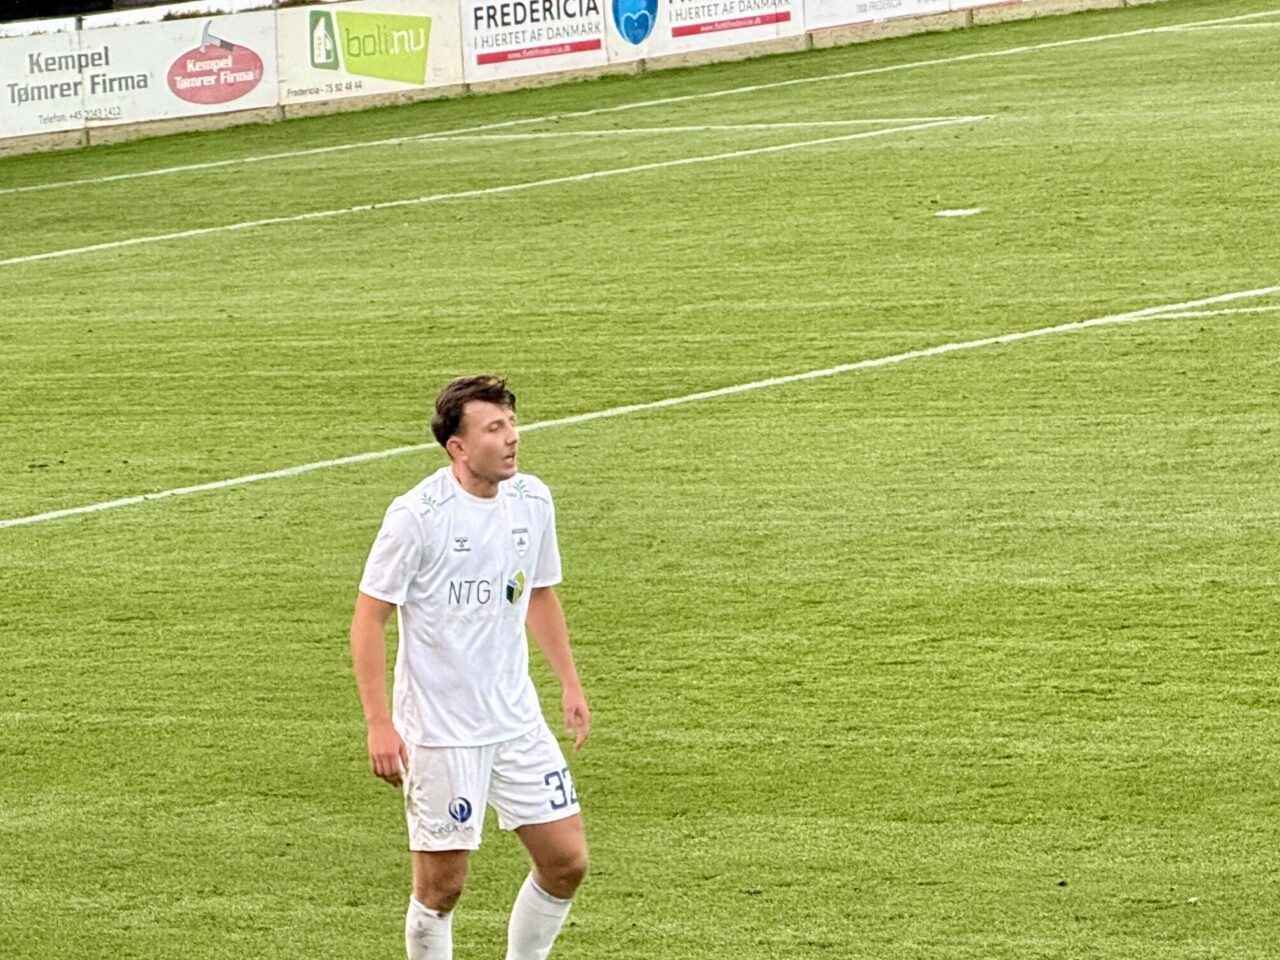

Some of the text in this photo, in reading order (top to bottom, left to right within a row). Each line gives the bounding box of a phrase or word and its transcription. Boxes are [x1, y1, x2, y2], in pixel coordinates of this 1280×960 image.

[474, 0, 600, 30] FREDERICIA
[675, 4, 719, 22] HJERTET
[722, 1, 735, 15] AF
[345, 24, 426, 58] boli.nu
[481, 30, 527, 49] HJERTET
[530, 28, 543, 42] AF
[547, 22, 601, 40] DANMARK
[29, 46, 109, 74] Kempel
[186, 54, 232, 72] Kempel
[8, 72, 149, 106] Tømrer Firma
[220, 71, 254, 85] Firma
[448, 579, 491, 605] NTG
